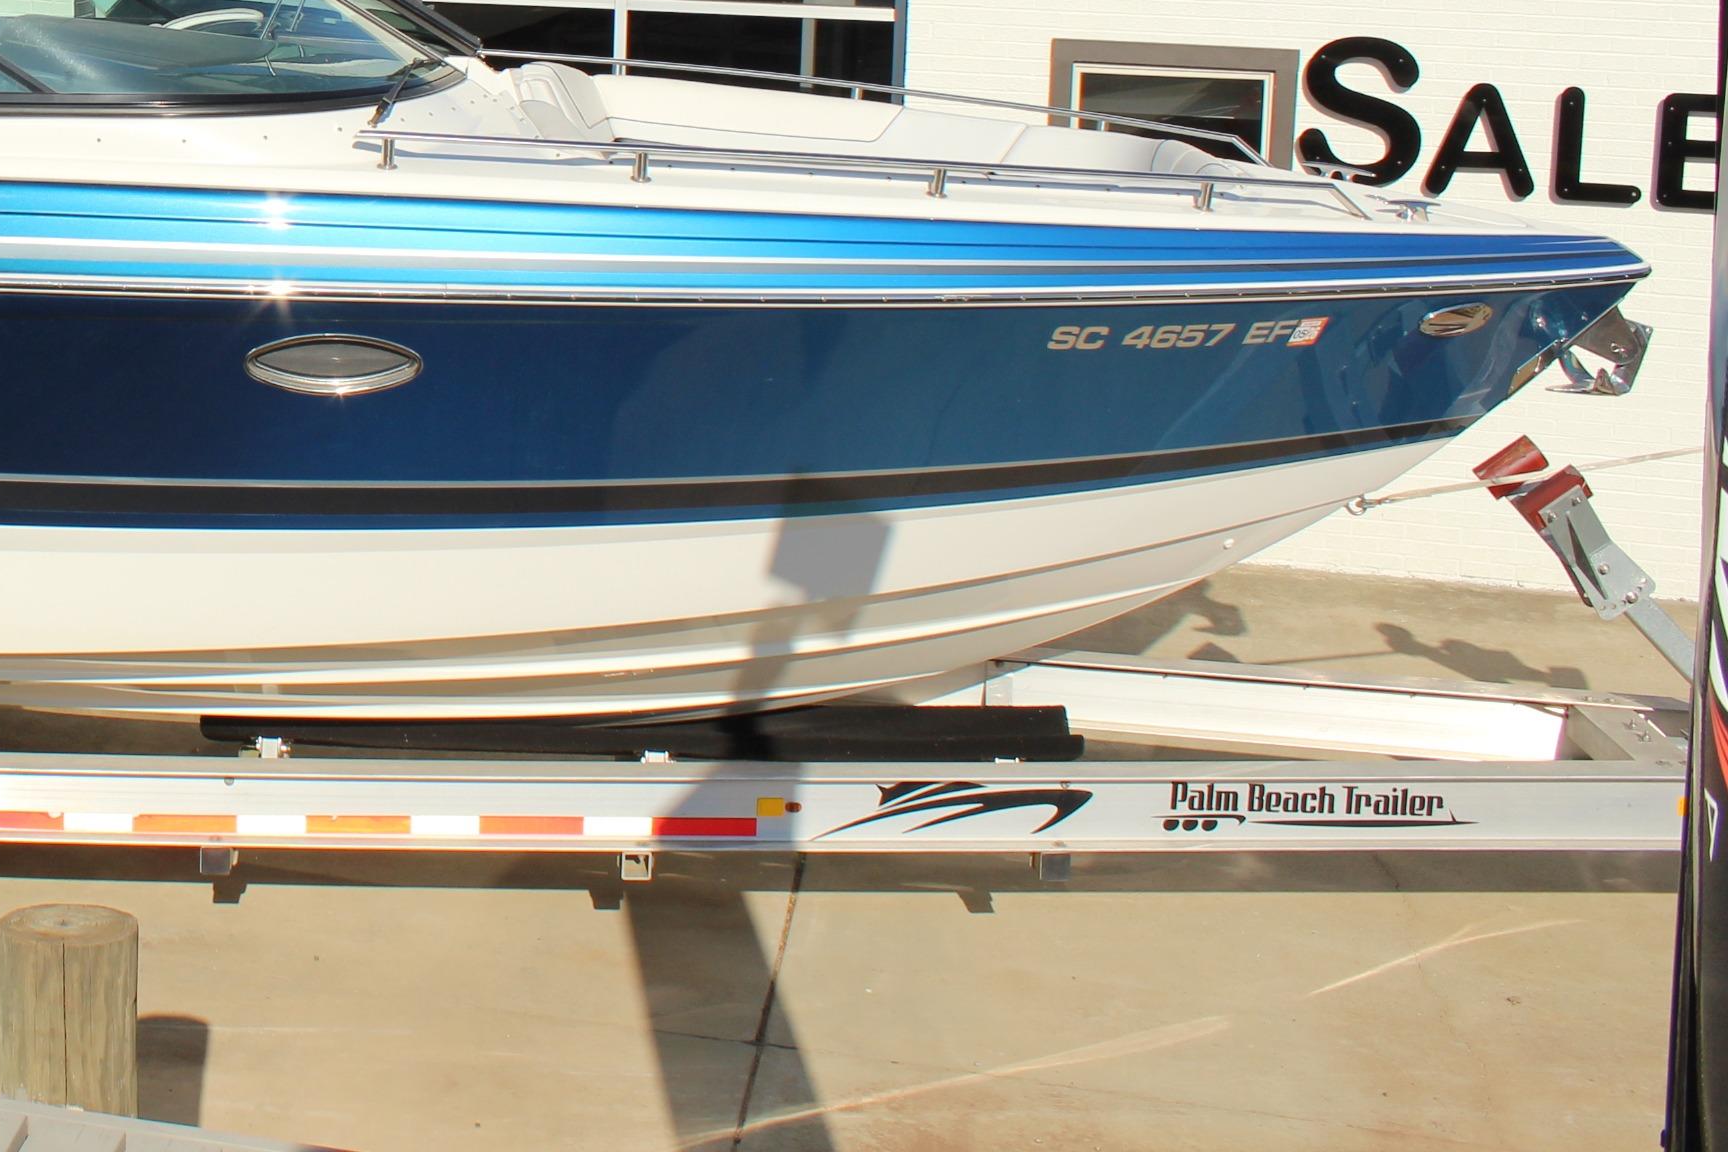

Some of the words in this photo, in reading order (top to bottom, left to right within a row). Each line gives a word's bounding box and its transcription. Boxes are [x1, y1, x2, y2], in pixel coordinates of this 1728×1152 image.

[1047, 326, 1110, 350] SC
[1122, 323, 1236, 349] 4657
[1242, 320, 1299, 345] EF
[1170, 780, 1239, 812] Palm
[1248, 783, 1335, 814] Beach
[1342, 785, 1445, 817] Trailer
